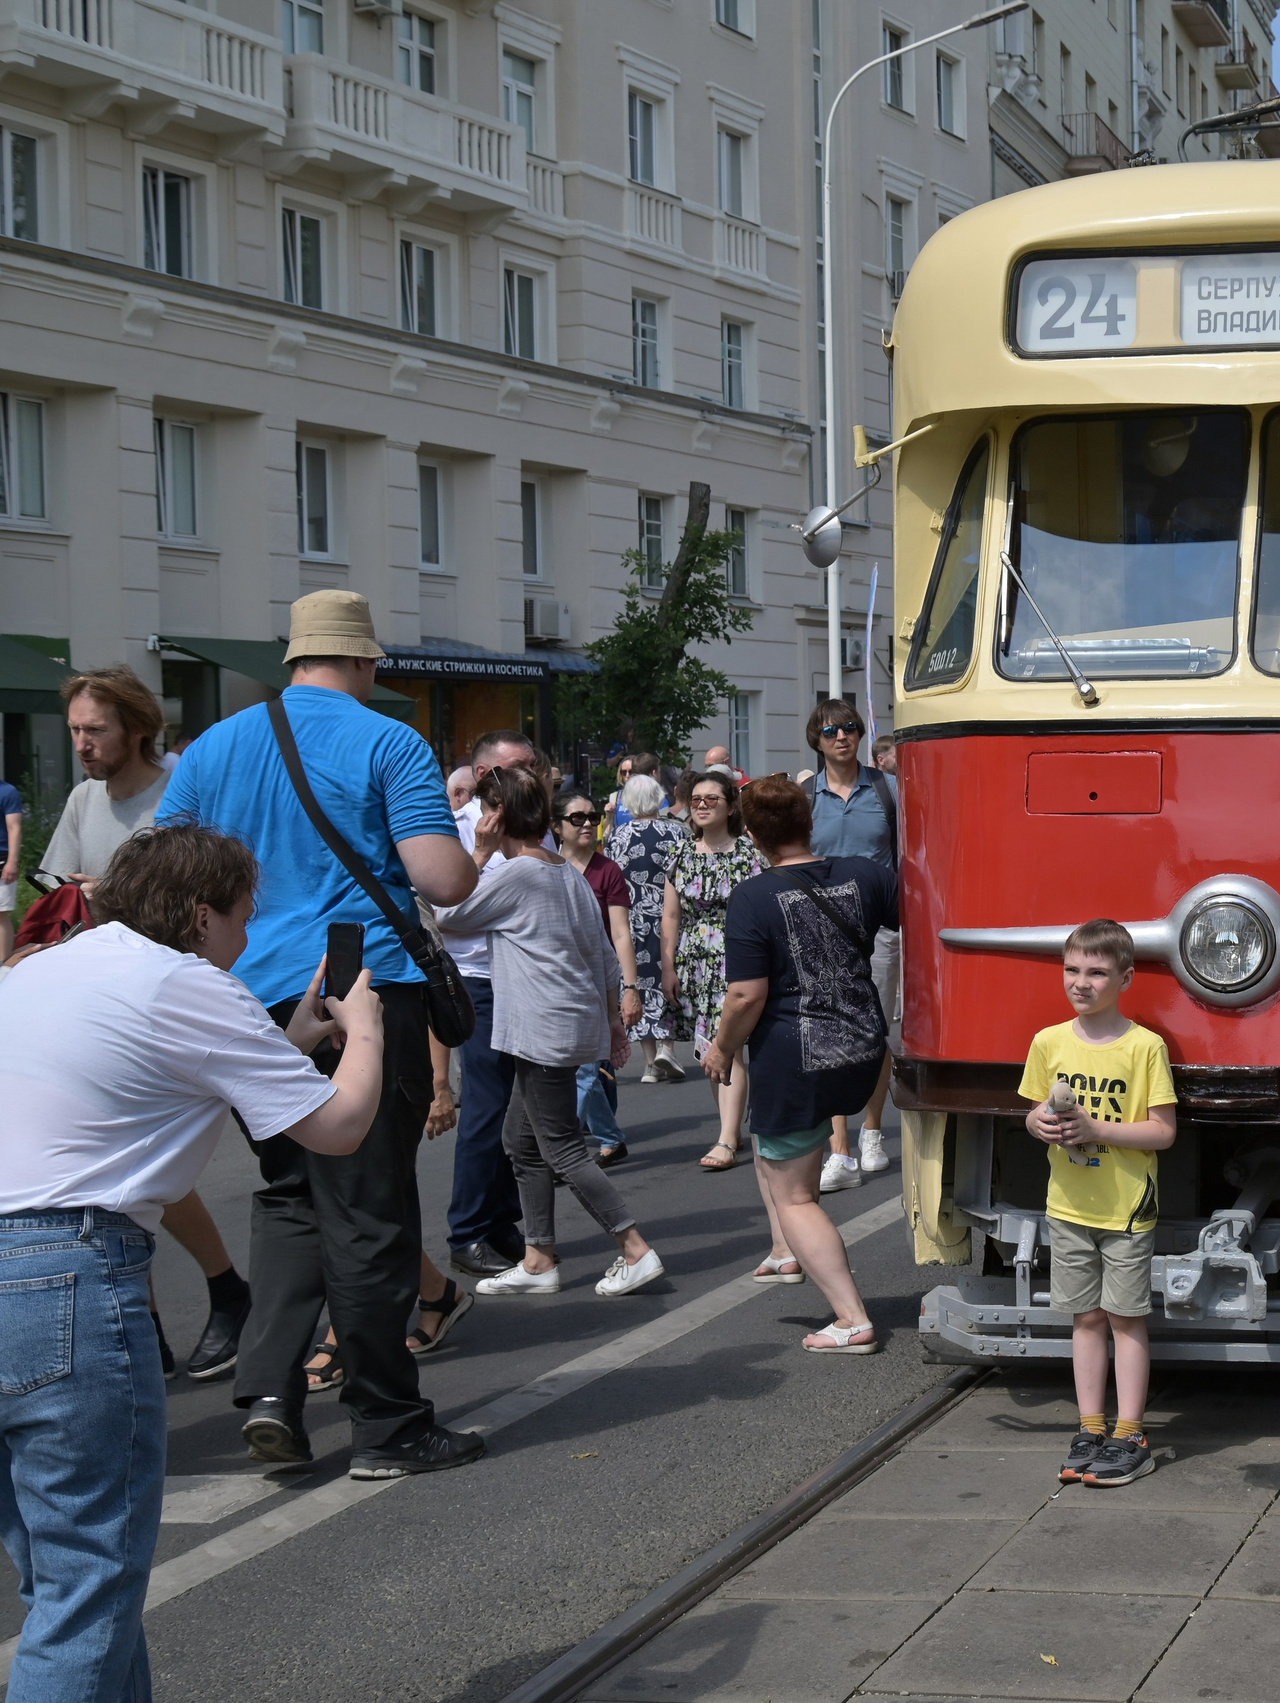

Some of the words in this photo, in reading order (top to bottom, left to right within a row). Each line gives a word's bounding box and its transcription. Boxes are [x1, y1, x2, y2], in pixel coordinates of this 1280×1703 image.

[1037, 273, 1126, 340] 24
[398, 658, 443, 672] МУЖСКИЕ
[443, 661, 486, 674] СТРИЖКИ
[487, 663, 494, 674] И
[495, 664, 544, 677] КОСМЕТИКА
[928, 647, 957, 673] 50012
